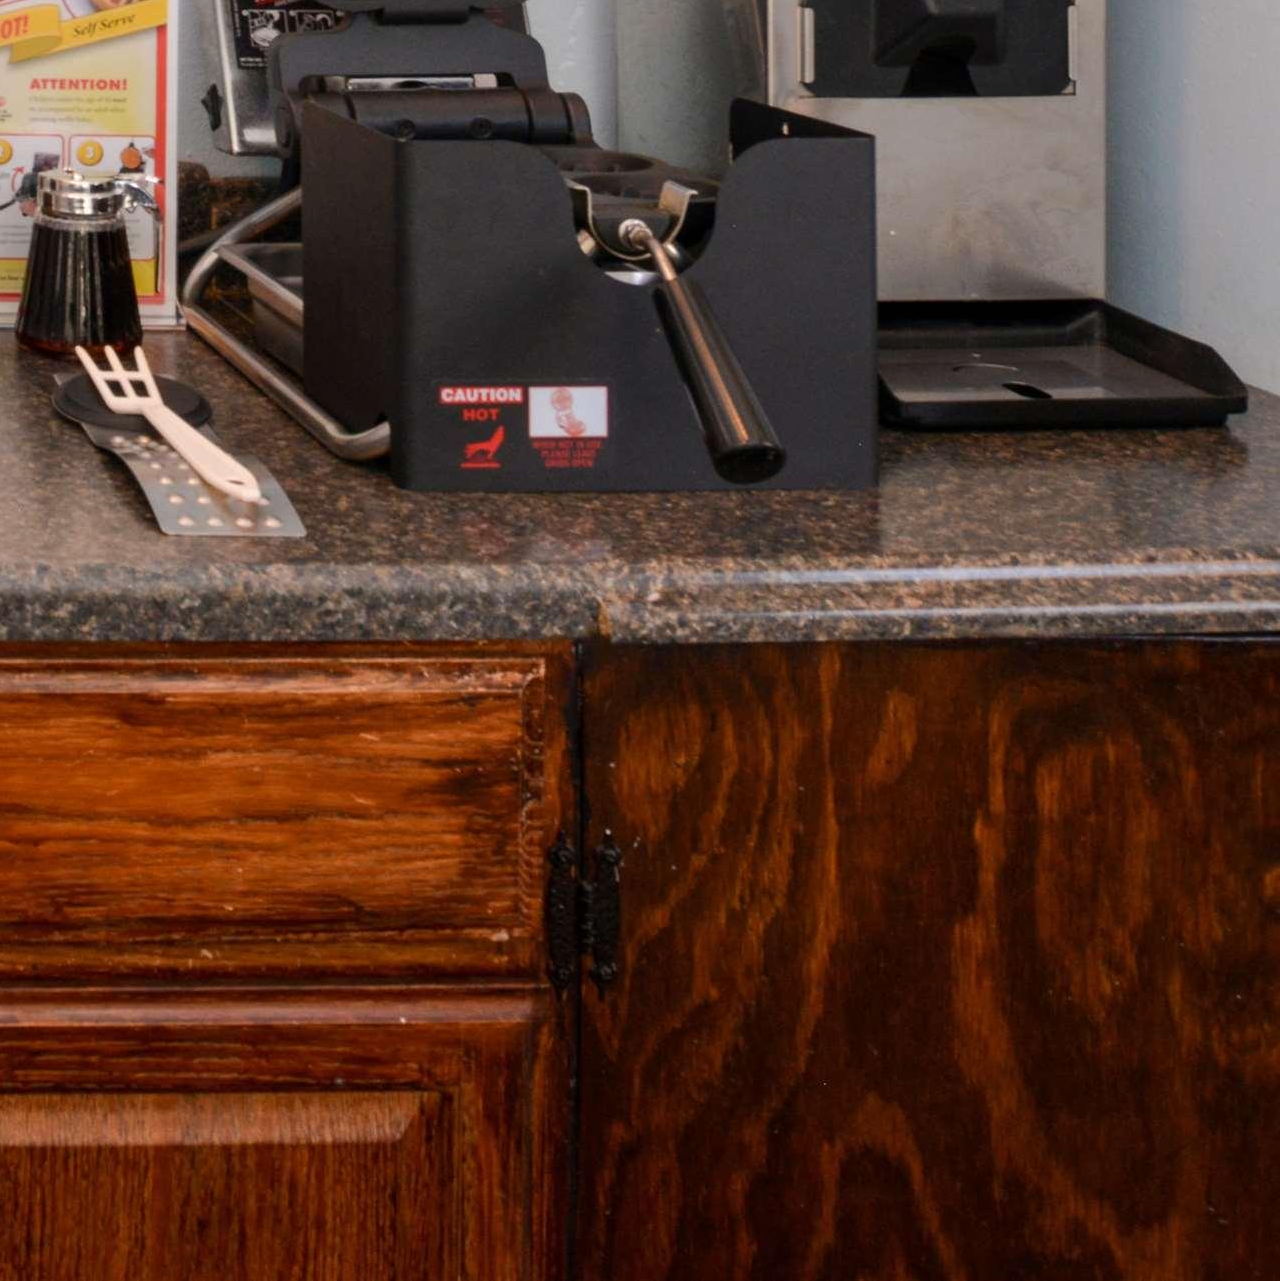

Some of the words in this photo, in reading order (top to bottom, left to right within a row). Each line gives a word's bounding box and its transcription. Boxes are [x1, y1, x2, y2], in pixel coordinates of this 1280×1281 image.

[73, 22, 97, 39] Self
[99, 14, 137, 31] Serve
[29, 78, 129, 91] ATTENTION!
[85, 145, 95, 158] 3
[440, 387, 522, 403] CAUTION
[463, 408, 500, 421] HOT
